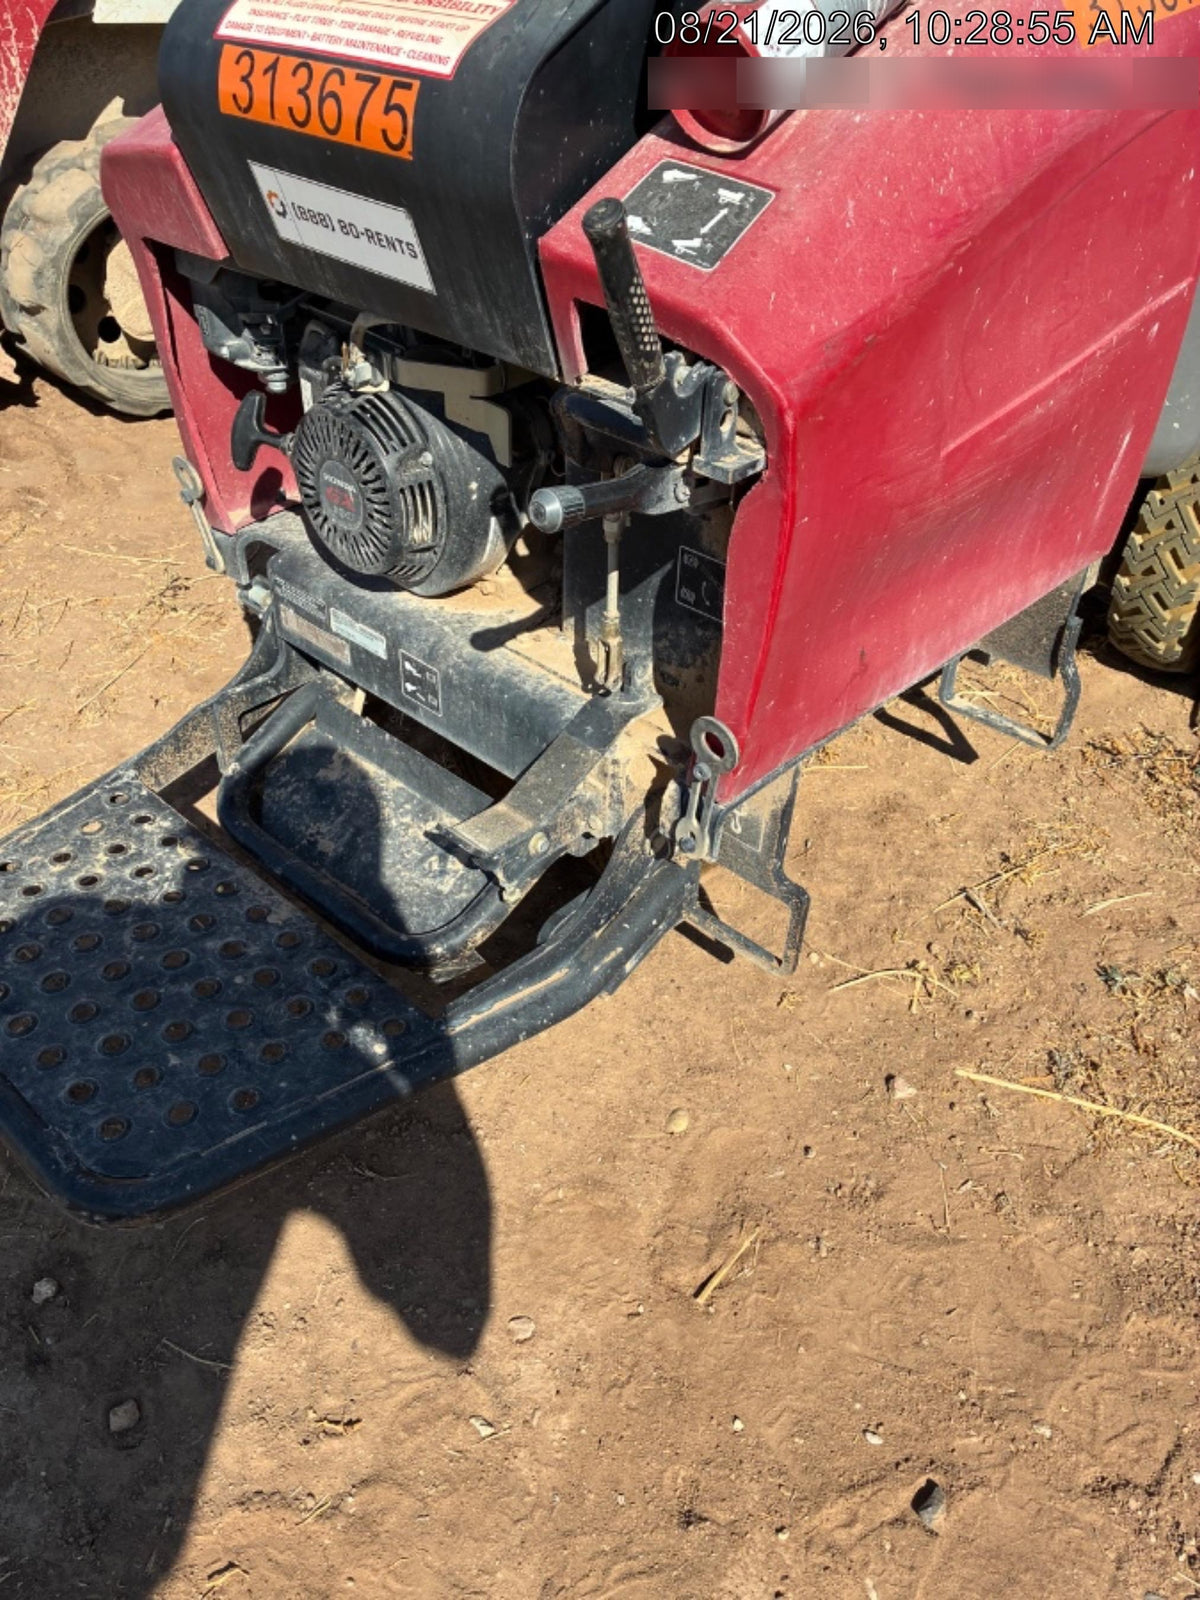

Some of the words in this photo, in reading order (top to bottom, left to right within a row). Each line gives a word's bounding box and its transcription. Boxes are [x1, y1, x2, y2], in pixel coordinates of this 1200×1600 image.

[225, 20, 255, 32] DAMAGE
[254, 23, 265, 33] TO
[264, 25, 307, 39] EQUIPMENT
[310, 31, 344, 44] BATTERY
[343, 37, 403, 56] MAINTENANCE
[406, 49, 451, 66] CLEANING
[356, 24, 392, 36] DAMAGE
[394, 29, 444, 45] REFUELING
[232, 49, 413, 152] 313675
[291, 201, 335, 232] (888)
[337, 218, 418, 260] 80-RENTS
